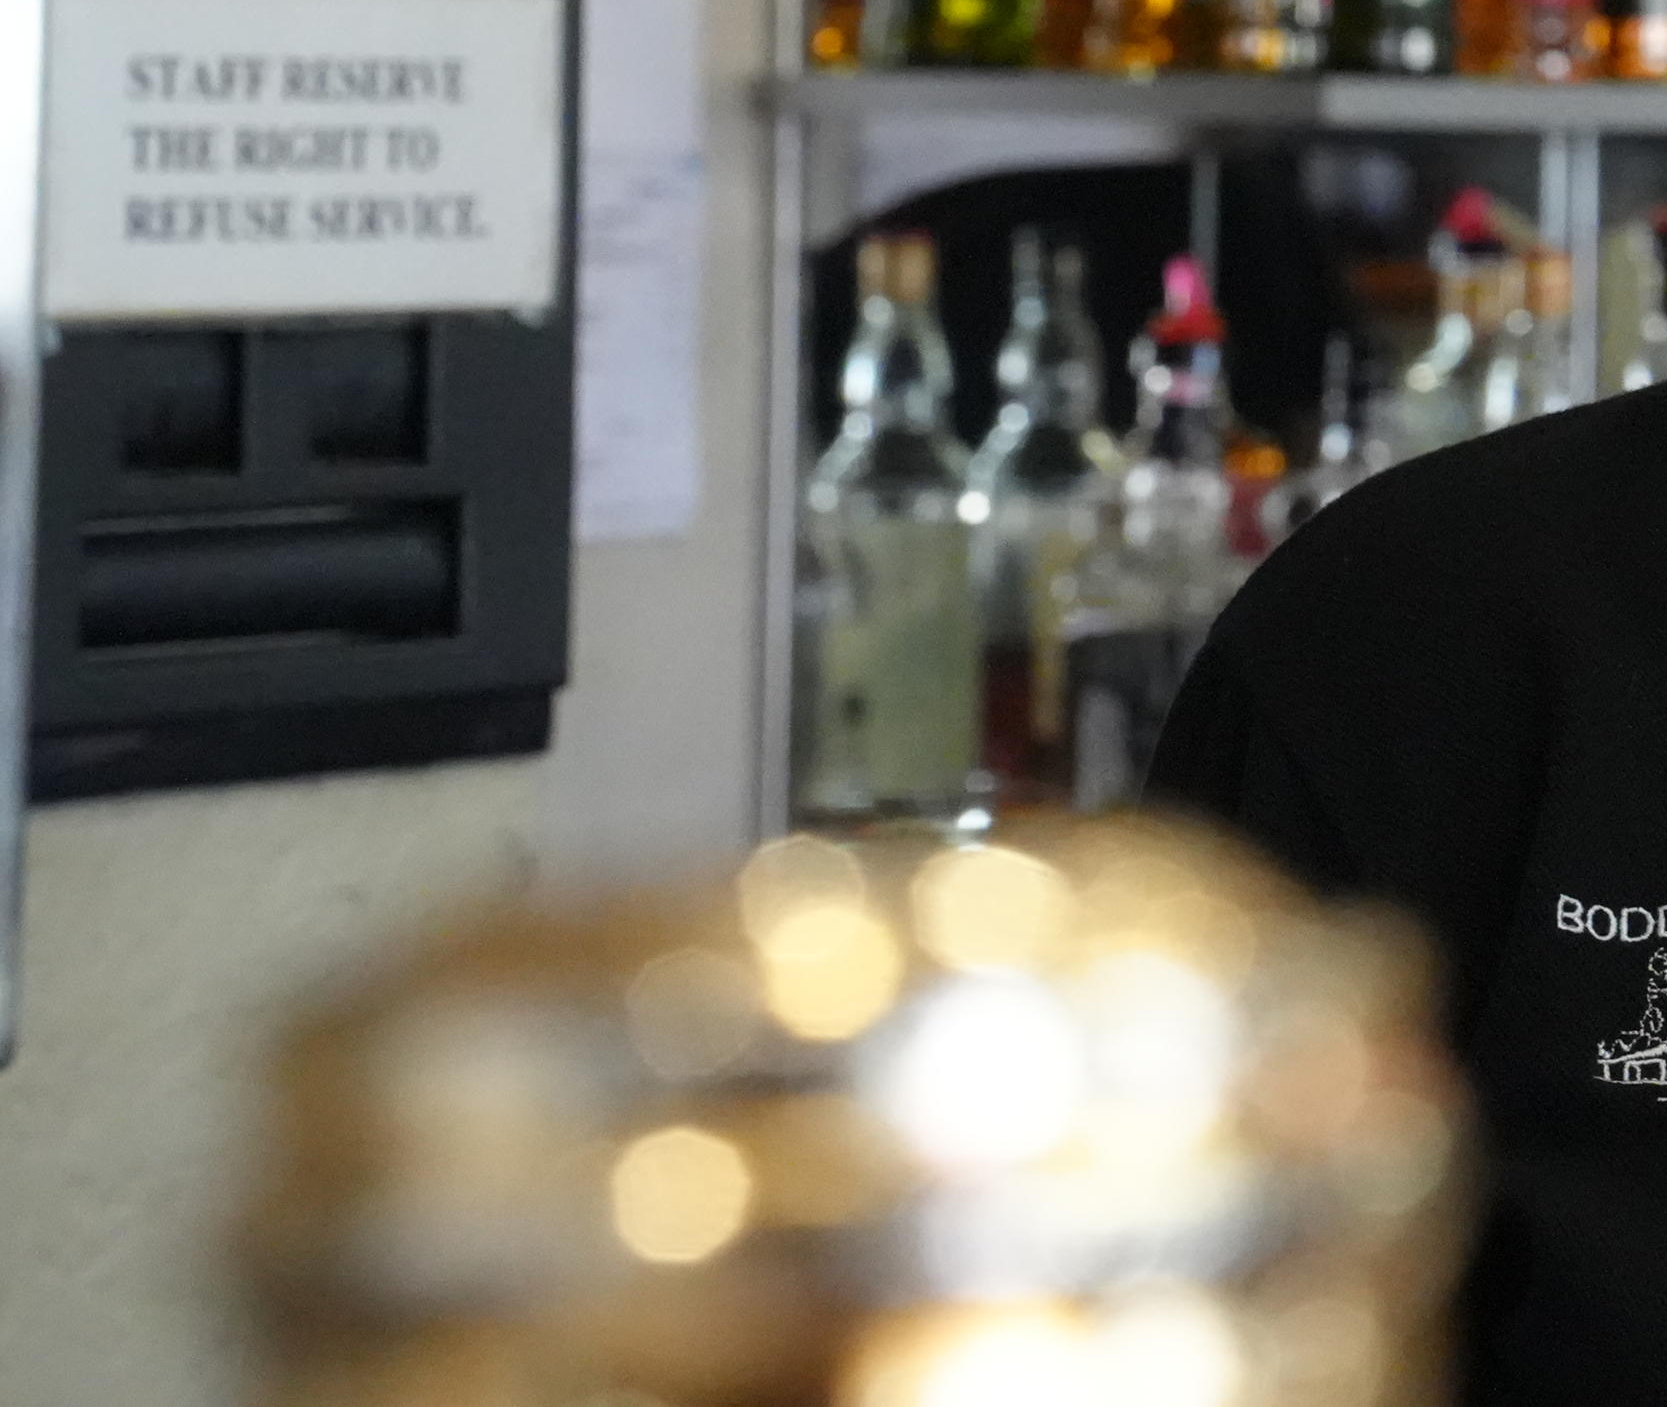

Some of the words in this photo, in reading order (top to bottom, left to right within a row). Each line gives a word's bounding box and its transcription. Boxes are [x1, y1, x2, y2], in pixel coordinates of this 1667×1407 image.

[125, 54, 267, 103] STAFF
[281, 55, 467, 104] RESERVE
[127, 124, 221, 174] THE
[235, 125, 368, 175] RIGHT
[385, 125, 441, 173] TO
[124, 194, 292, 244] REFUSE
